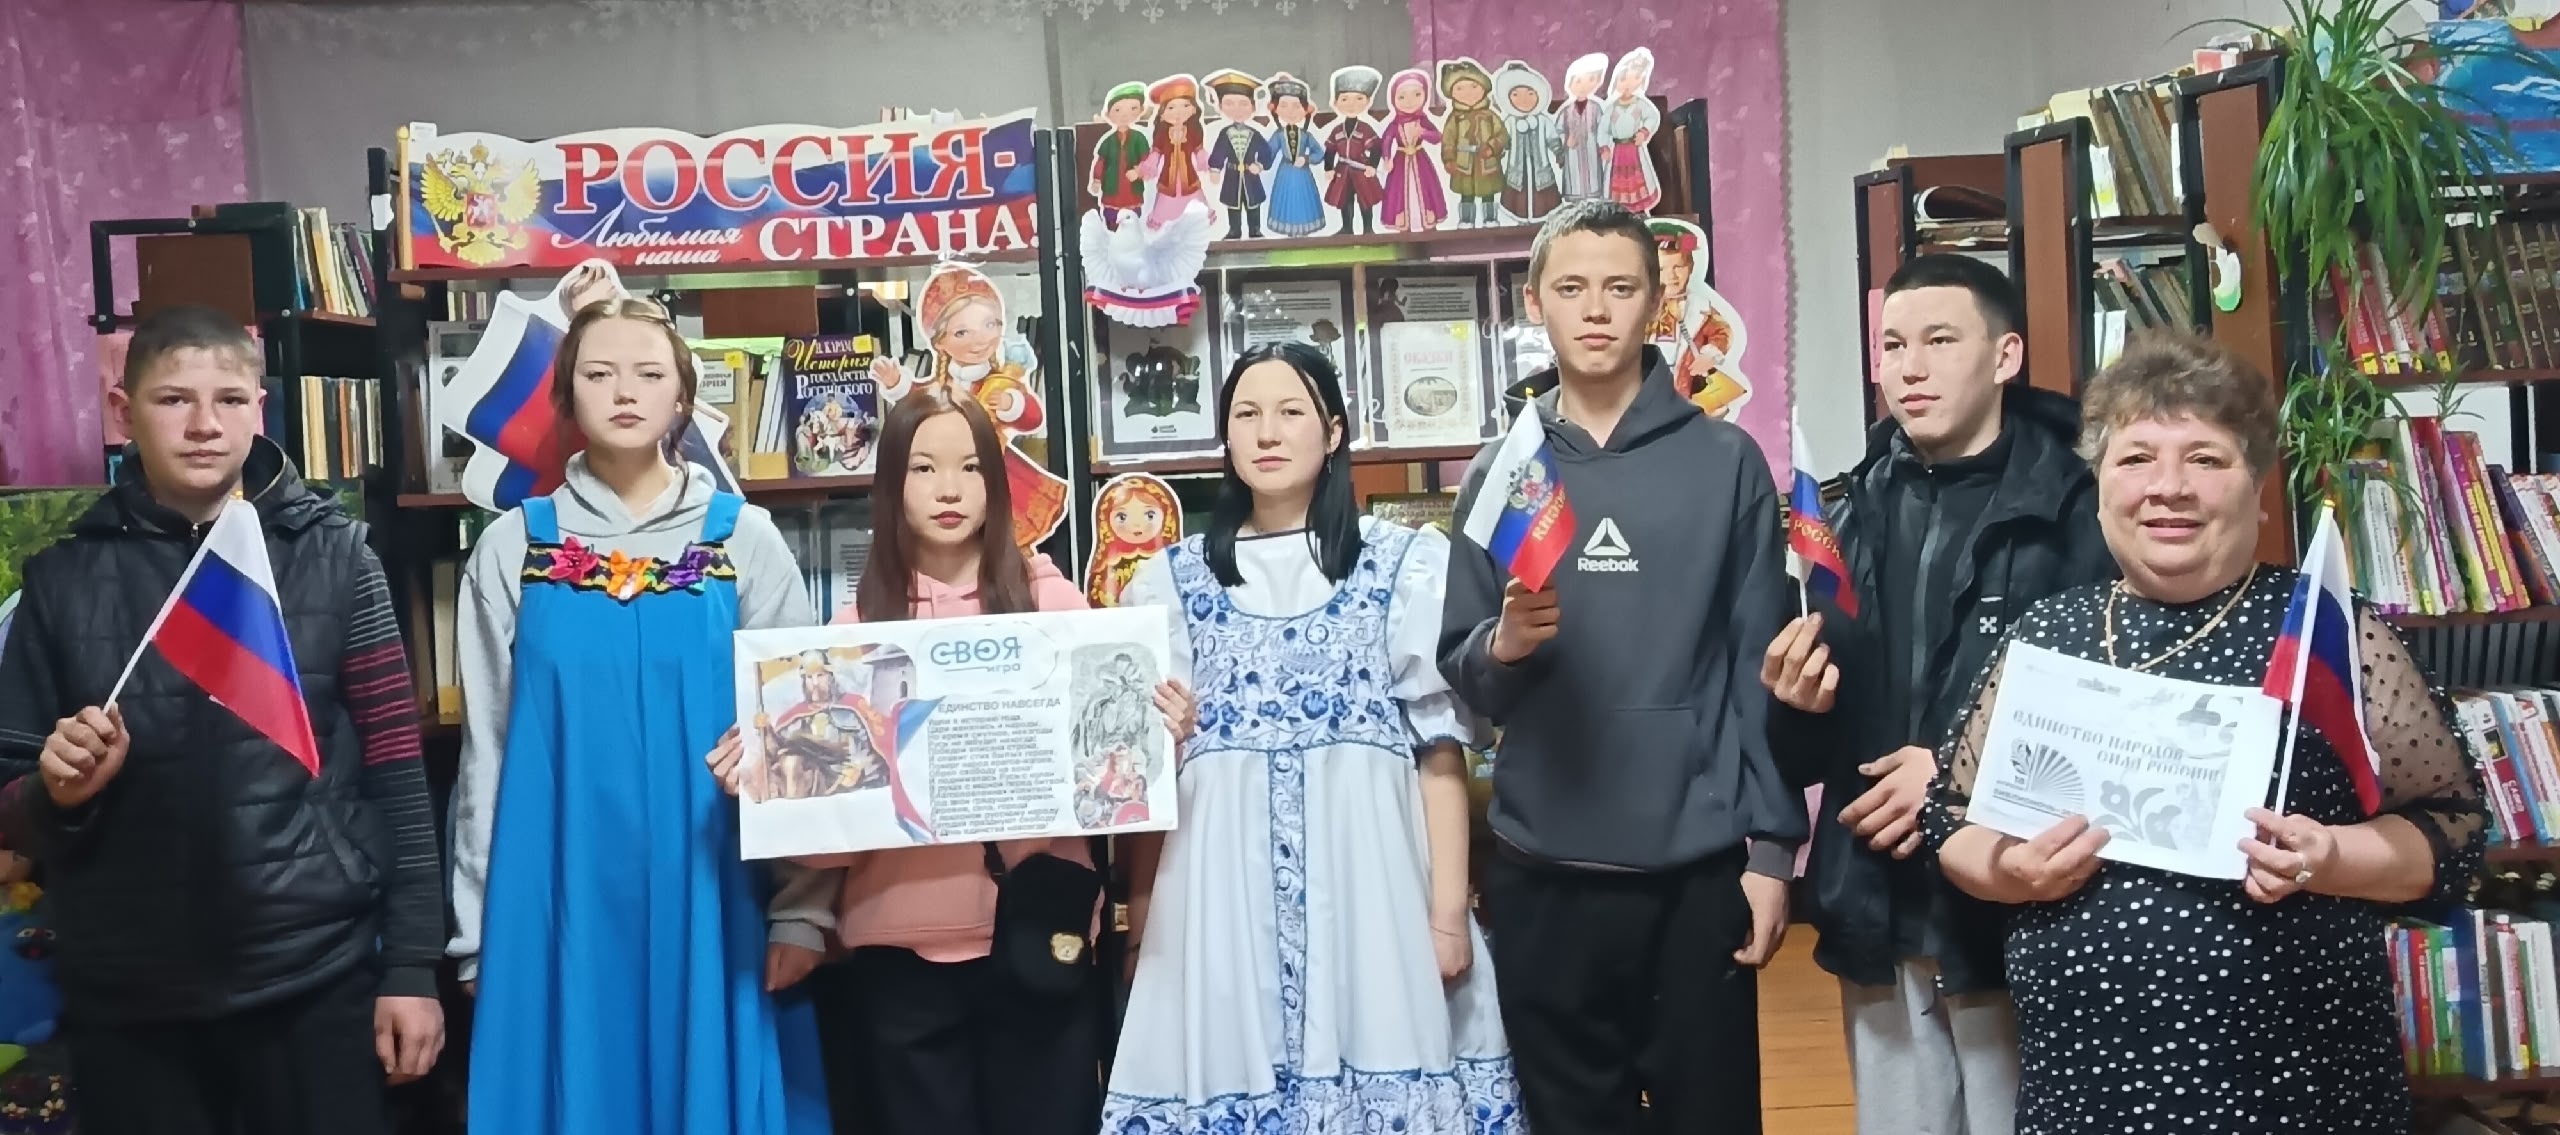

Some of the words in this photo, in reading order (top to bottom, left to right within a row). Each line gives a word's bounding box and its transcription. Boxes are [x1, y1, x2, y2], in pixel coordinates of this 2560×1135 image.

[554, 126, 1017, 215] РОССИЯ-
[551, 199, 744, 250] Любимая
[759, 202, 1040, 263] СТРАНА!
[634, 248, 721, 267] наша
[786, 338, 870, 376] История
[1793, 519, 1842, 561] РОССИ
[1578, 557, 1640, 572] Reebok
[930, 636, 1022, 666] СВОЯ
[987, 662, 1021, 674] игра
[938, 700, 999, 714] ЕДИНСТВО
[1002, 698, 1061, 709] НАВСЕГДА
[2013, 710, 2104, 745] ЕДИНСТВО
[2108, 735, 2184, 761] НАРОДОВ
